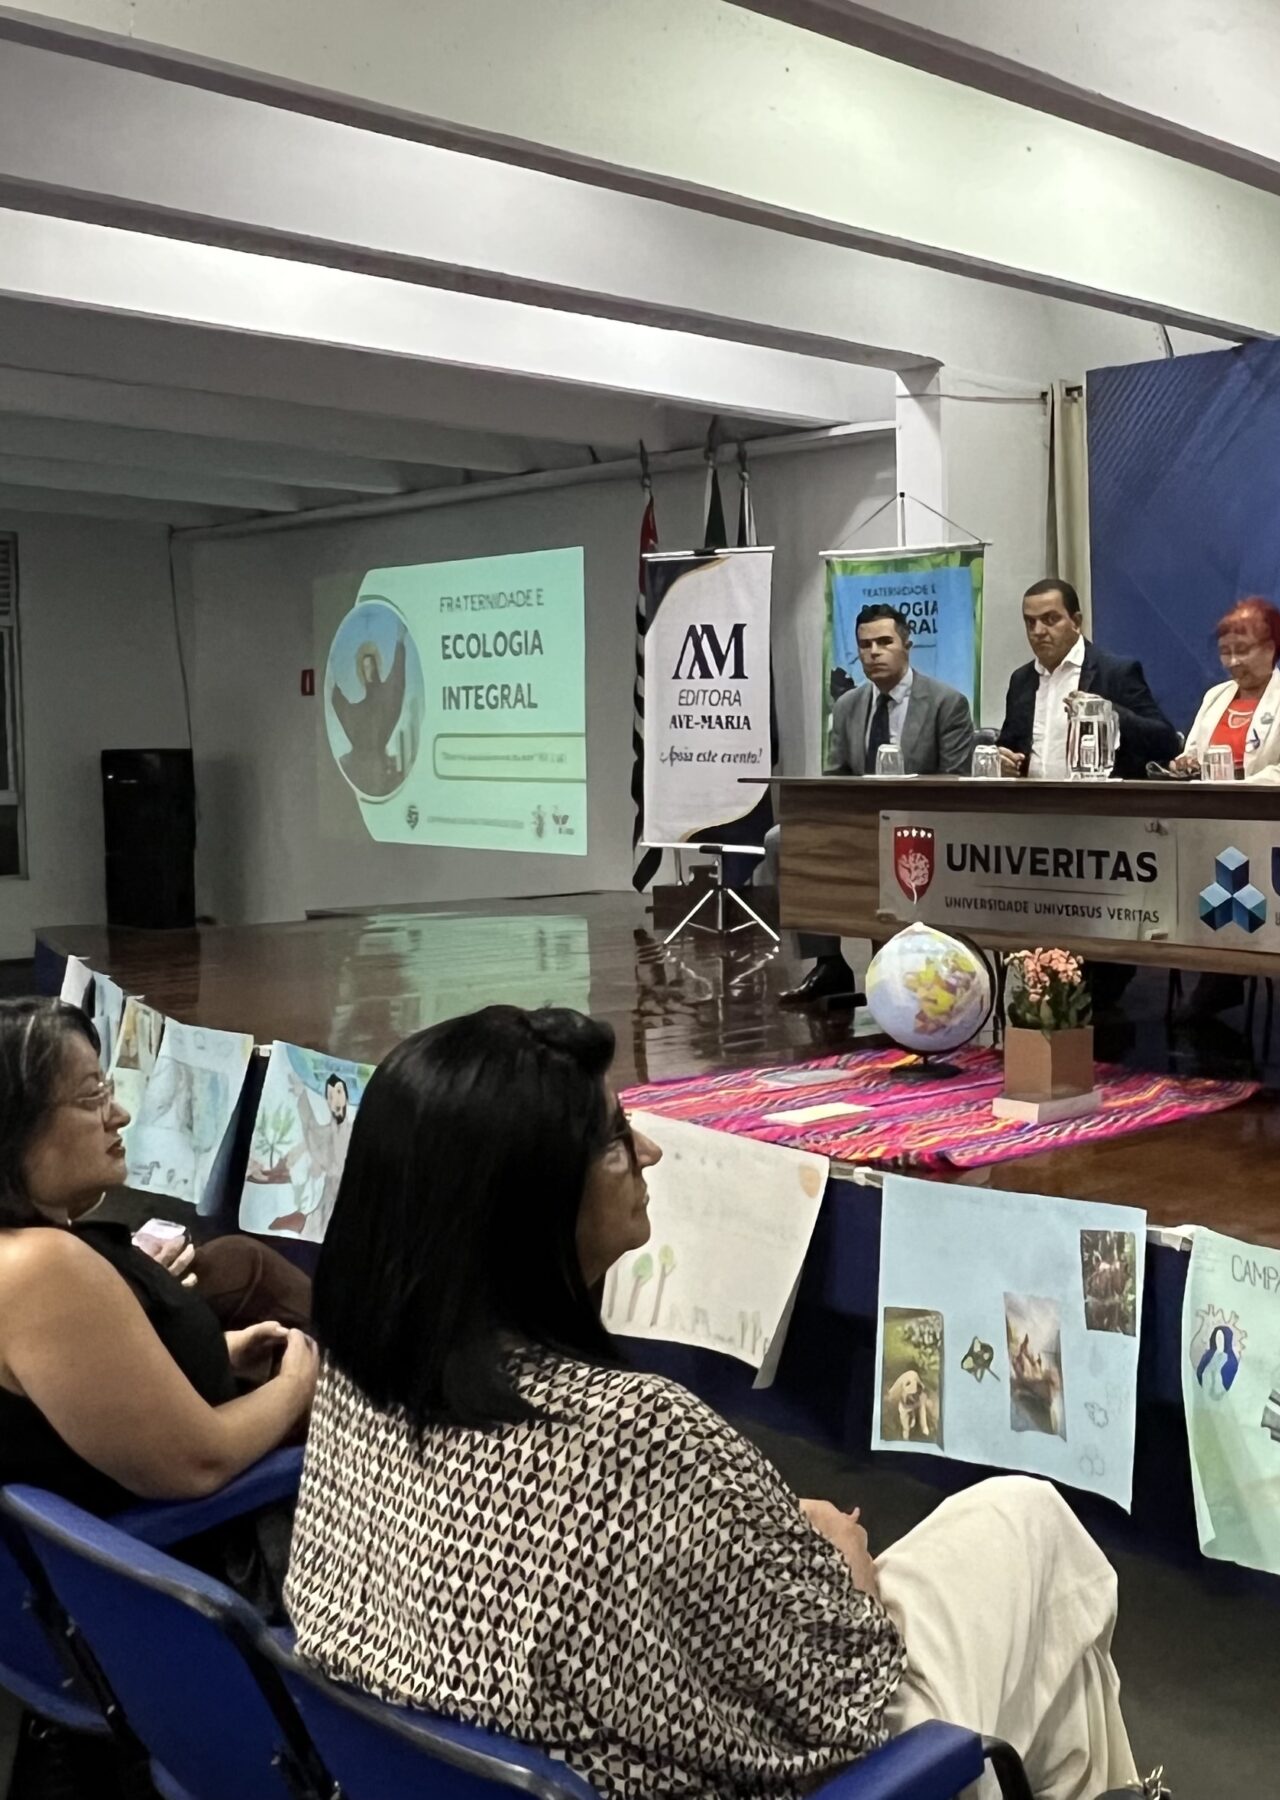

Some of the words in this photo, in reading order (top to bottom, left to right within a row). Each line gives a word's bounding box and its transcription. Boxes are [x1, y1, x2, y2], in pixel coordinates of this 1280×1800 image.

[536, 588, 545, 606] E
[441, 629, 544, 660] ECOLOGIA
[672, 623, 749, 679] AM
[442, 683, 538, 711] INTEGRAL
[678, 688, 742, 707] EDITORA
[669, 714, 752, 731] AVE-MARIA
[697, 749, 718, 763] este
[721, 748, 763, 764] evento!
[946, 843, 1158, 883] UNIVERITAS
[944, 896, 1029, 915] UNIVERSIDADE
[1034, 902, 1102, 919] UNIVERSUS
[1107, 907, 1160, 924] VERITAS
